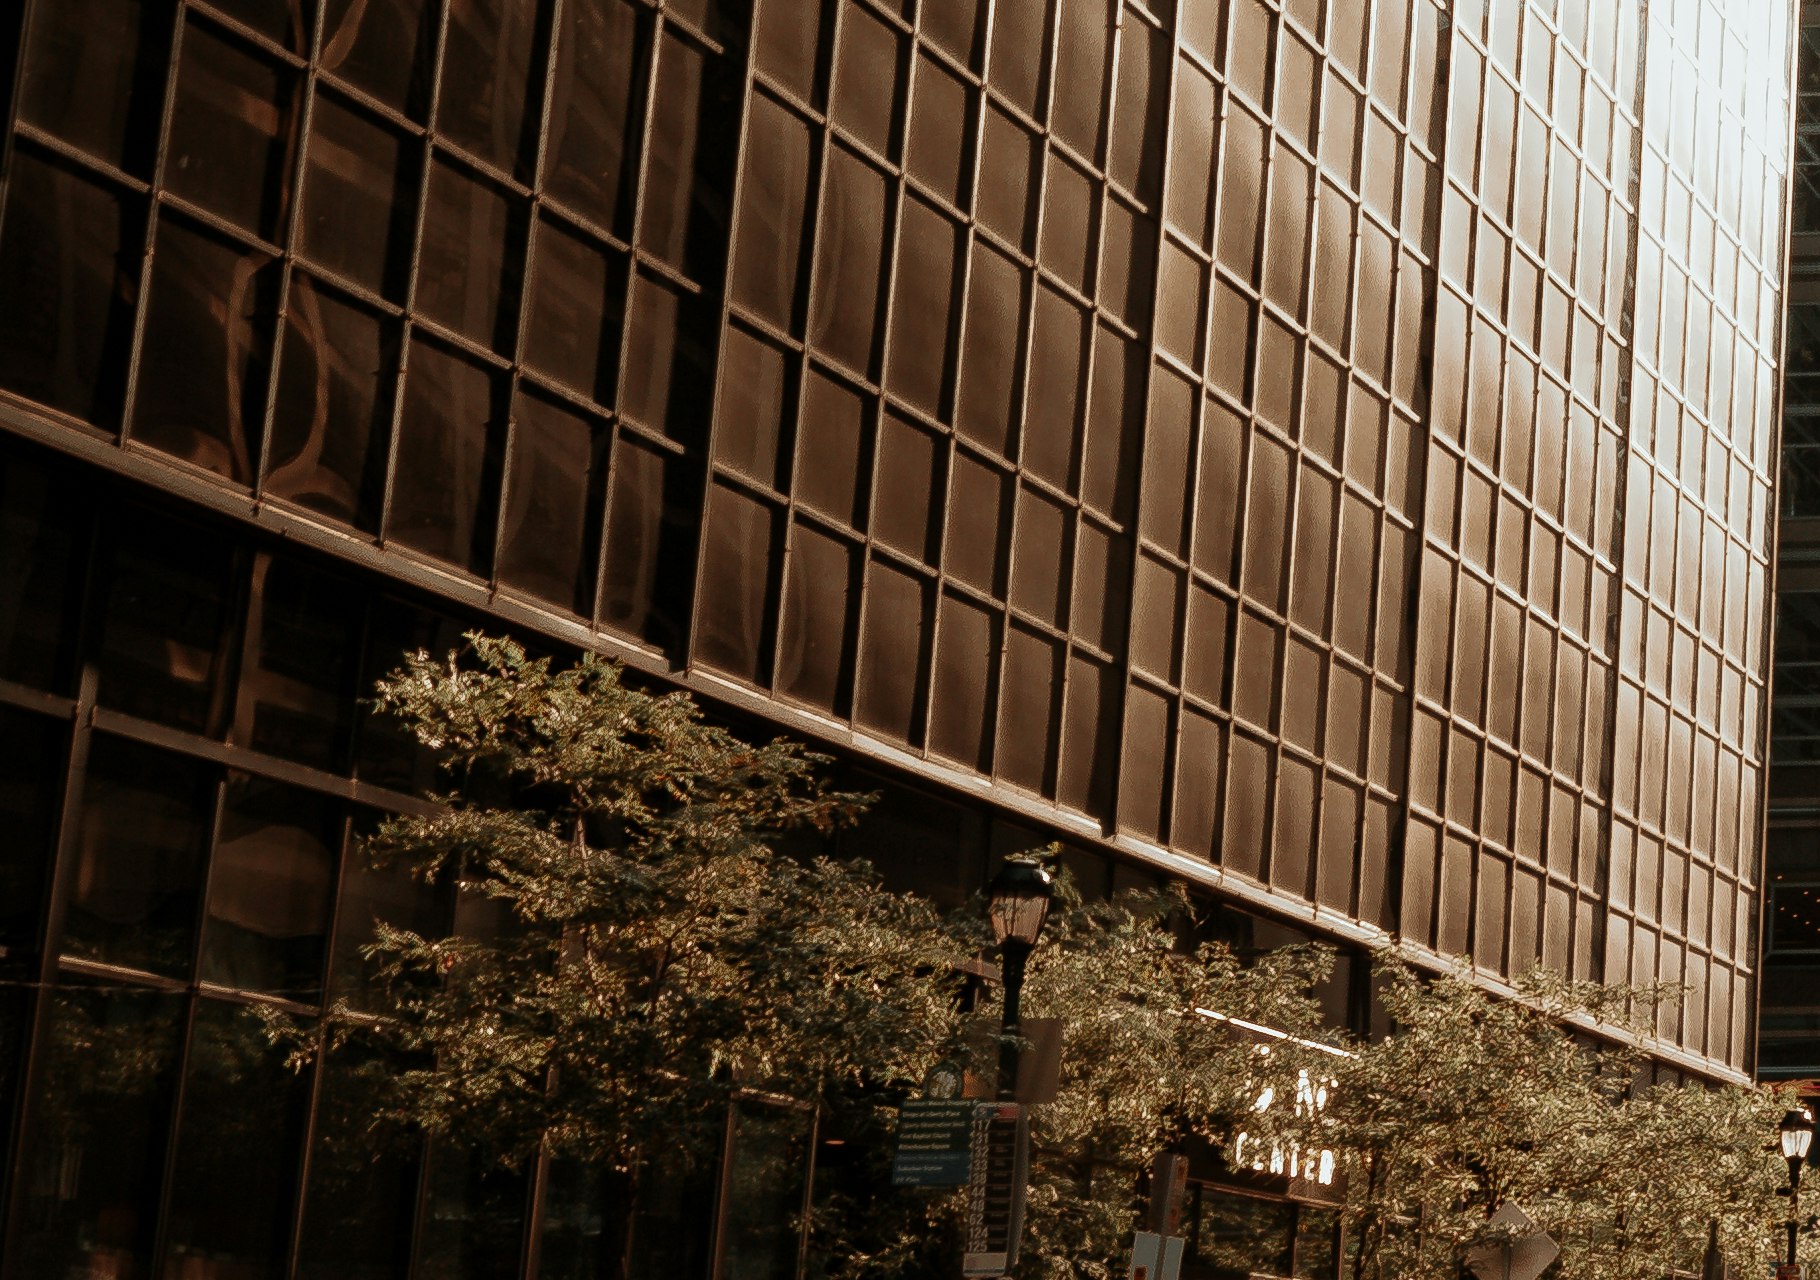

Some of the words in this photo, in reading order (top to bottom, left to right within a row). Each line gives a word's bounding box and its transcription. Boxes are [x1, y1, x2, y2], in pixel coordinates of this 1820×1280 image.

[971, 1186, 986, 1197] 44
[969, 1214, 983, 1225] 62
[968, 1227, 988, 1239] 124
[967, 1240, 988, 1252] 125
